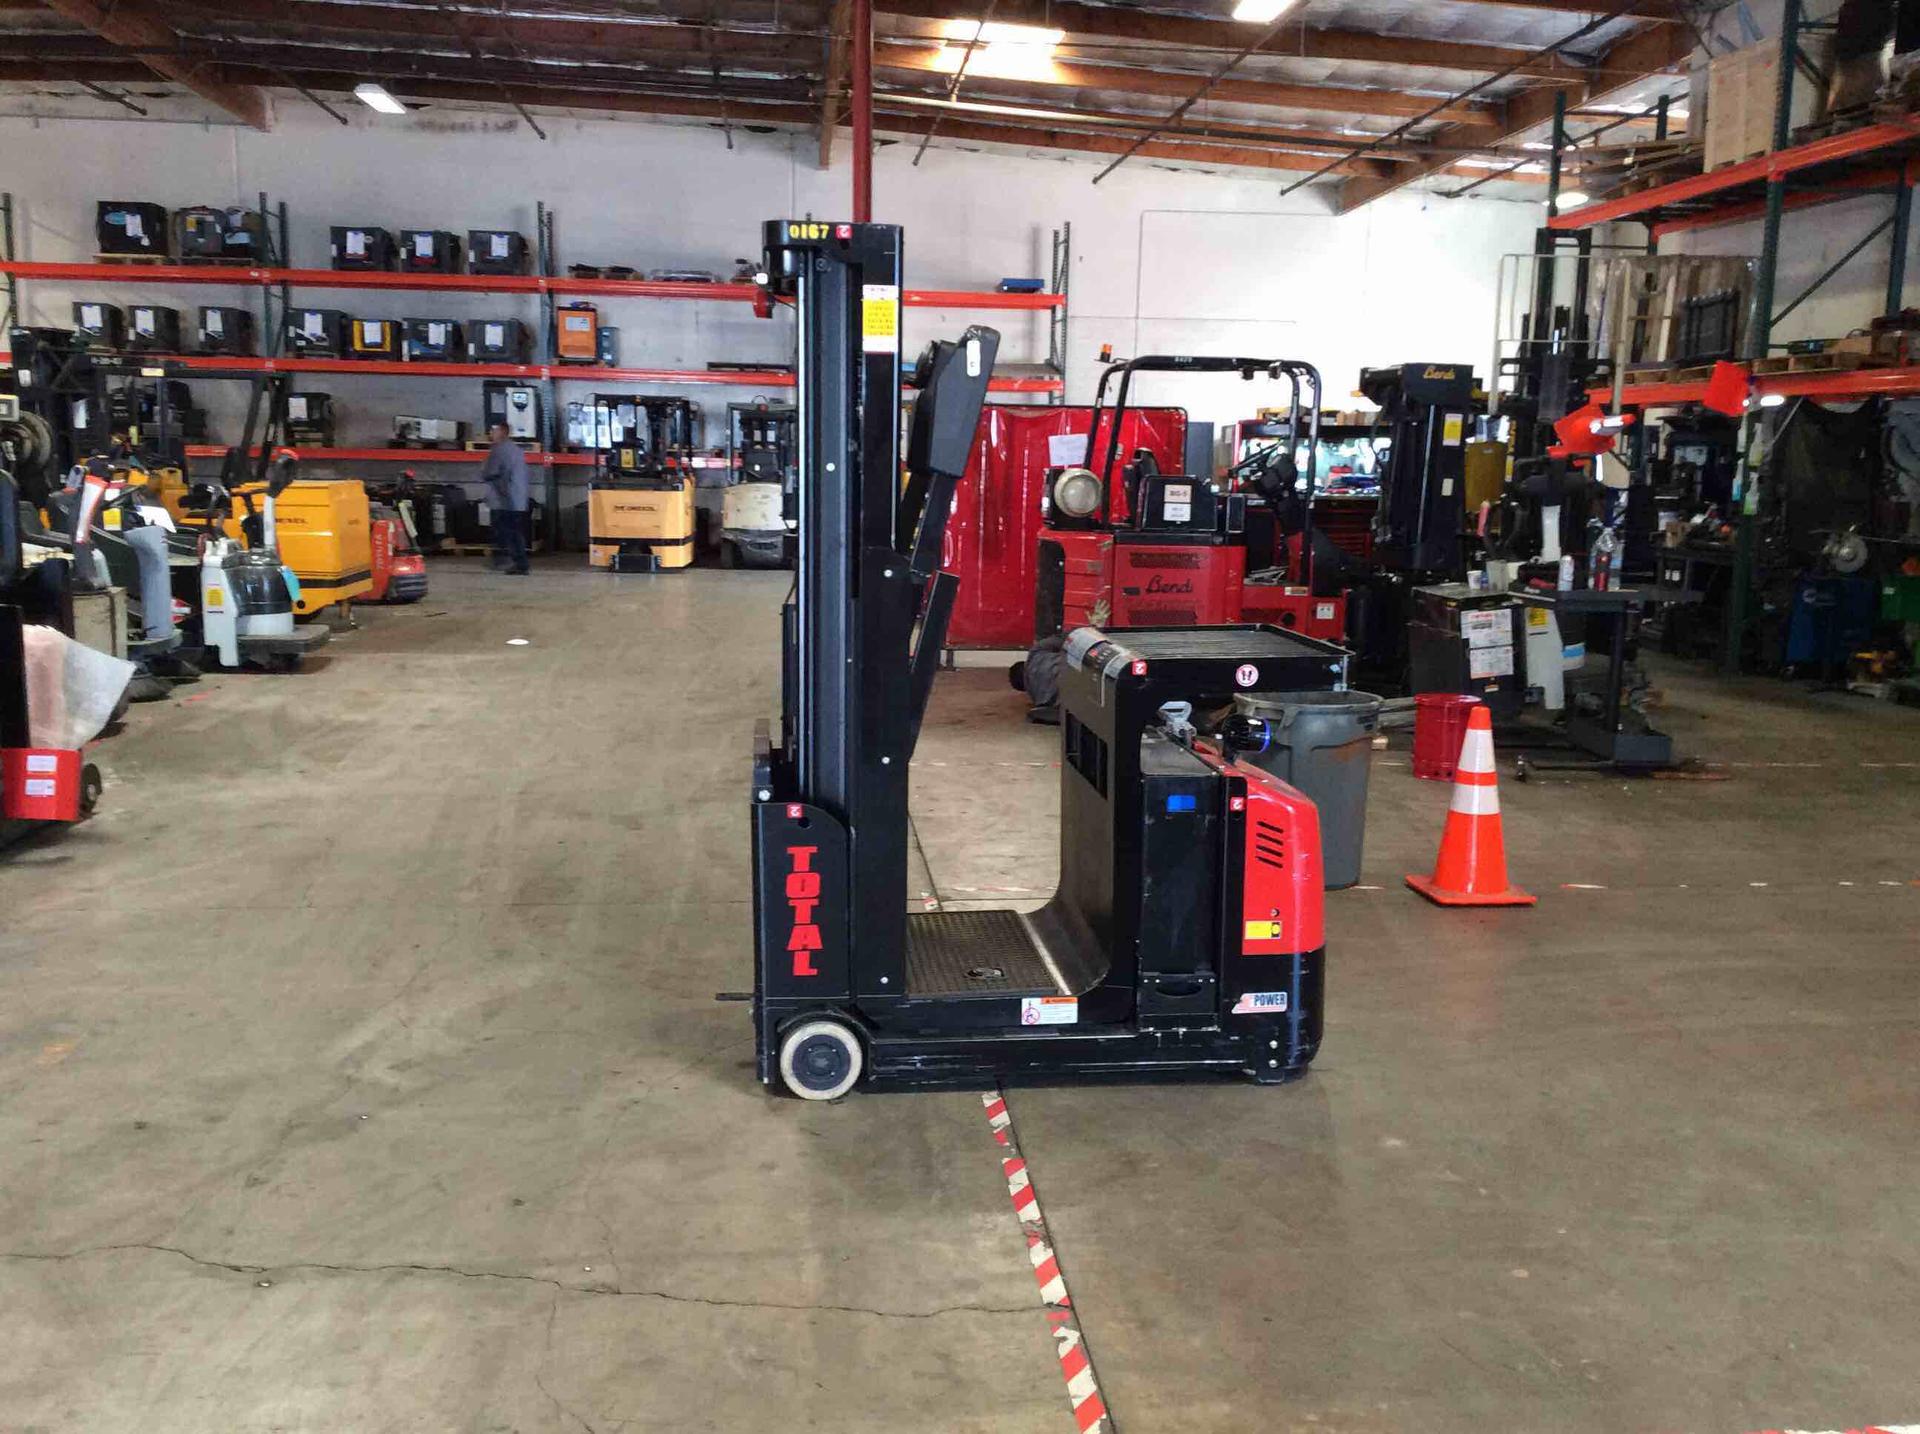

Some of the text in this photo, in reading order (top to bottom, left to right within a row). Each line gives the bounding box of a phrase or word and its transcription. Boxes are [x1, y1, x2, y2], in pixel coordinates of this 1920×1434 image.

[789, 224, 829, 239] 0167
[786, 846, 824, 976] TOTAL
[1254, 993, 1285, 1006] POWER
